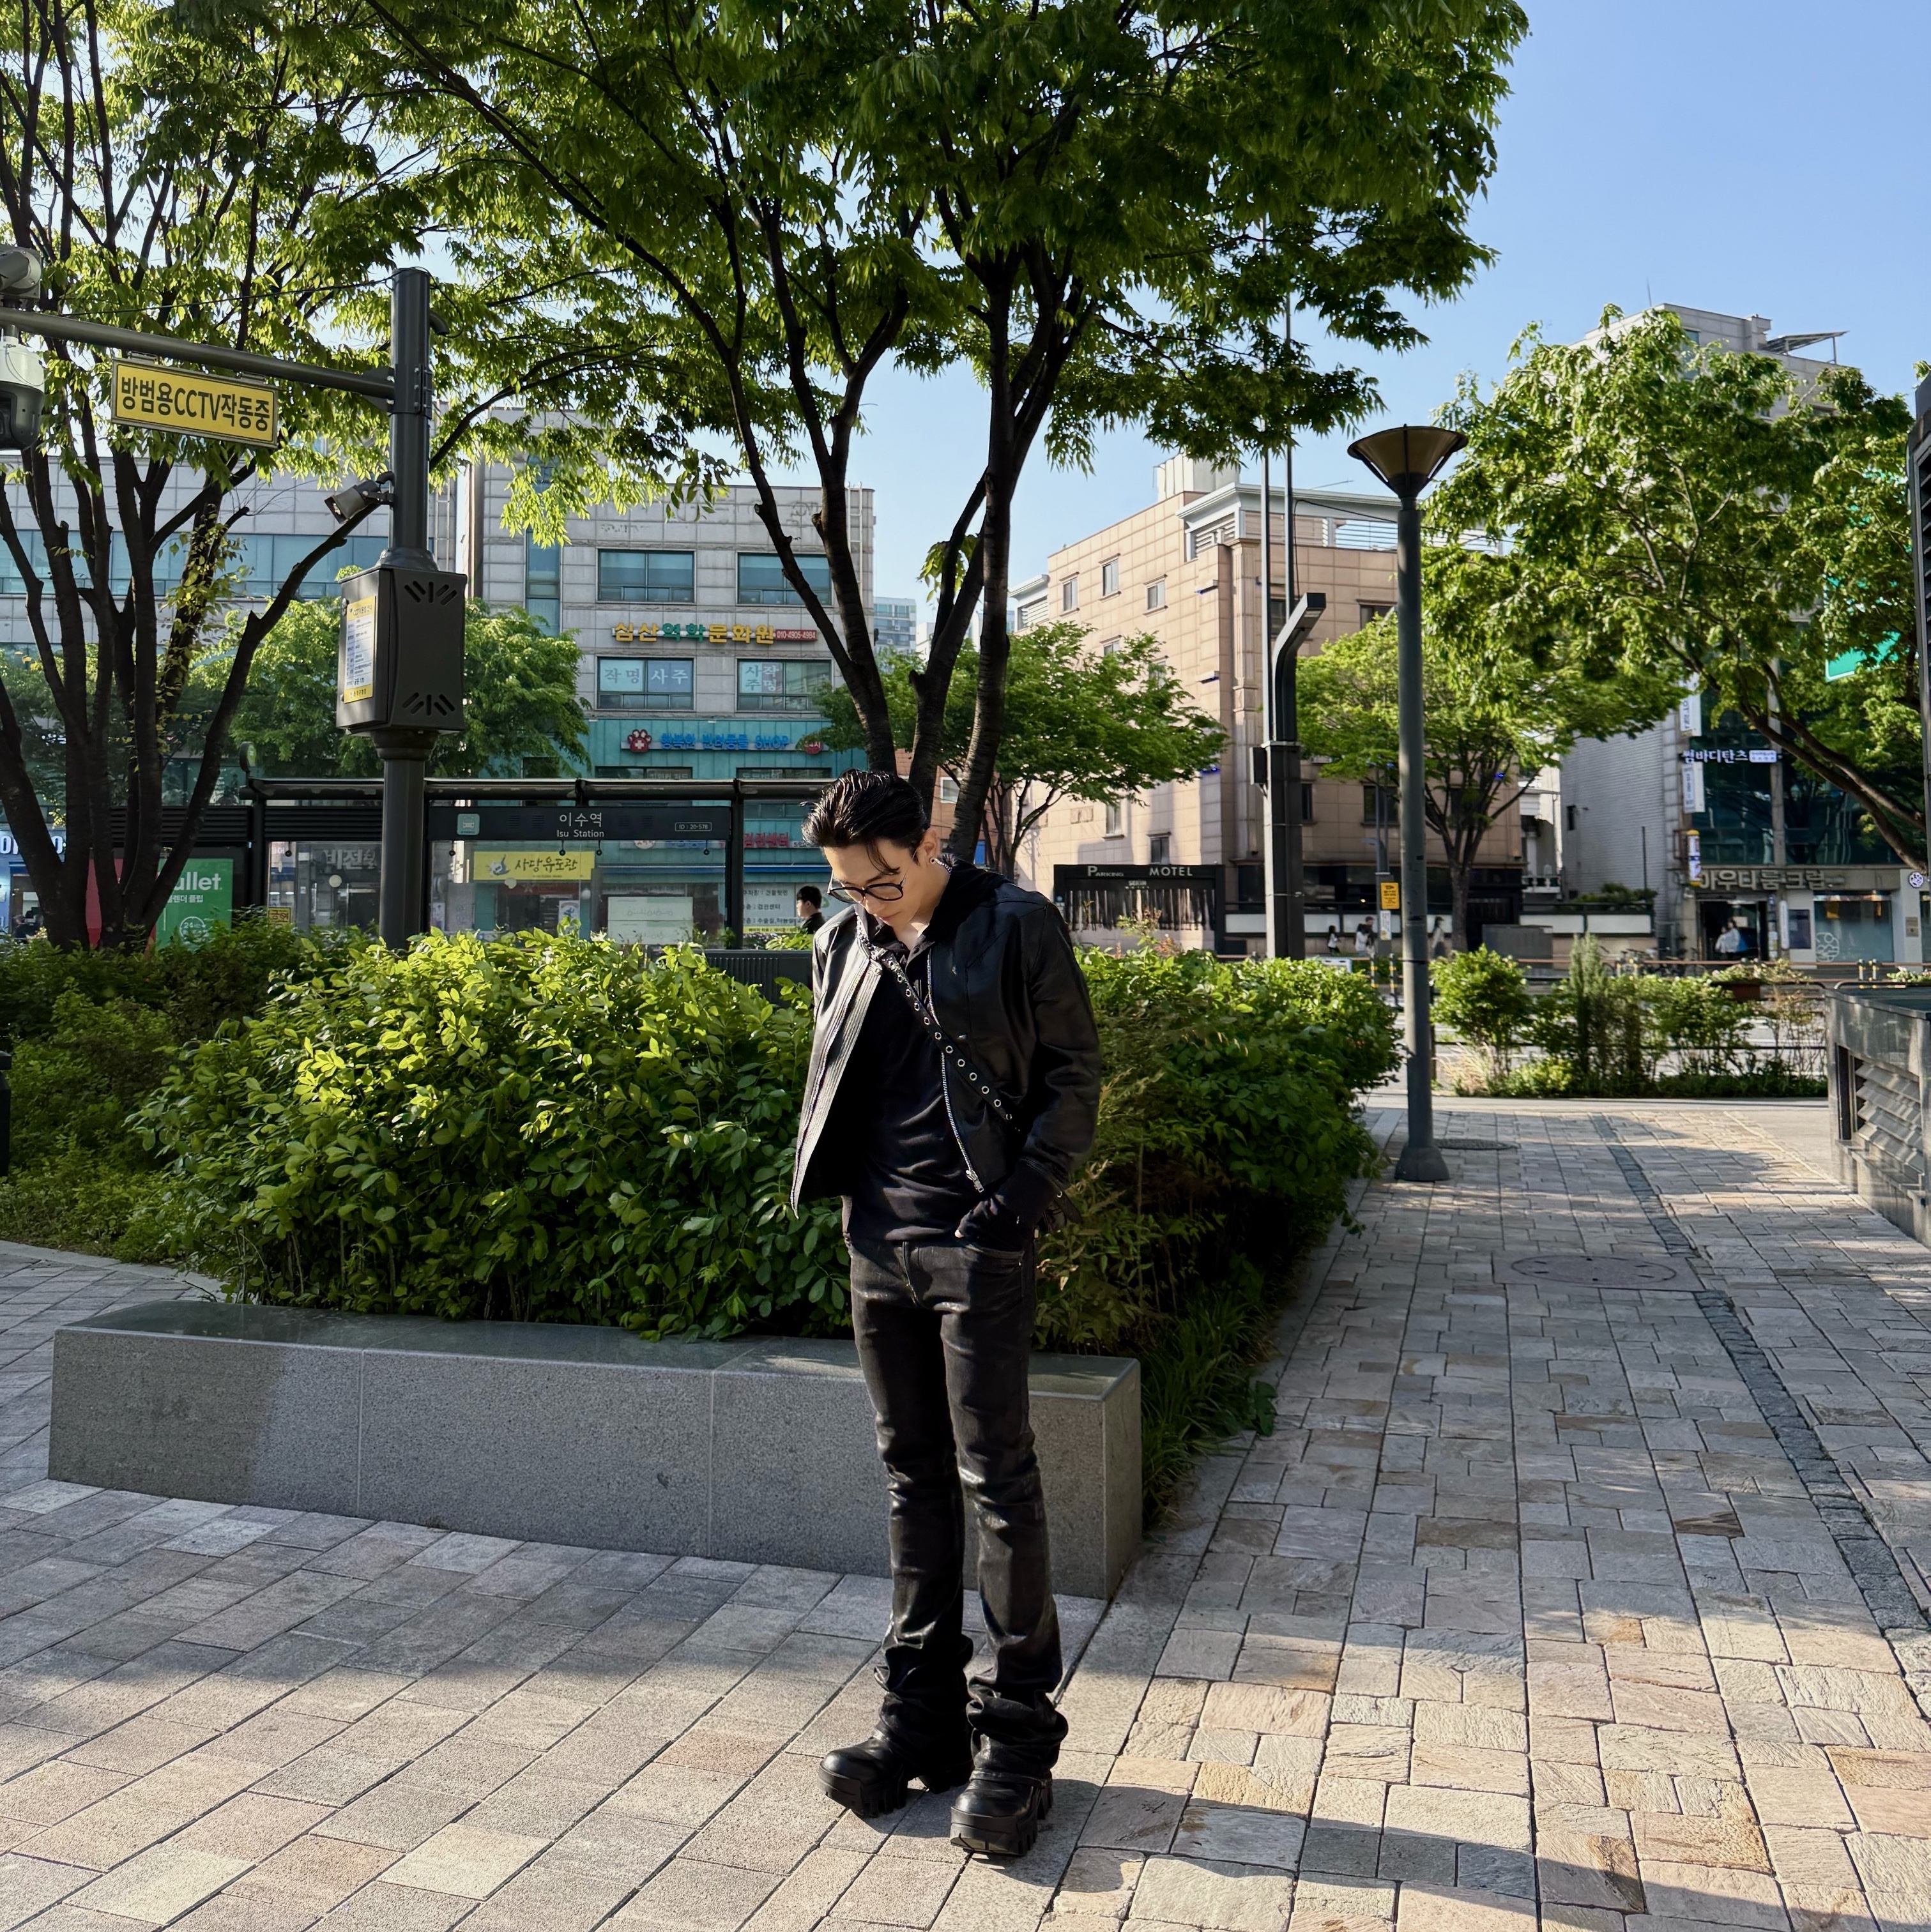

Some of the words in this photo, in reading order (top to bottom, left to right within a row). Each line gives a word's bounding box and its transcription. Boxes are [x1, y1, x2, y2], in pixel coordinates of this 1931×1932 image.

[121, 376, 270, 432] 방범용CCTV작동중
[604, 667, 639, 683] 작명
[650, 668, 688, 684] 사주
[754, 734, 789, 749] SHOP
[559, 812, 602, 827] 이수역
[556, 830, 569, 838] Isu
[573, 829, 604, 838] Station
[1150, 867, 1193, 876] MOTEL
